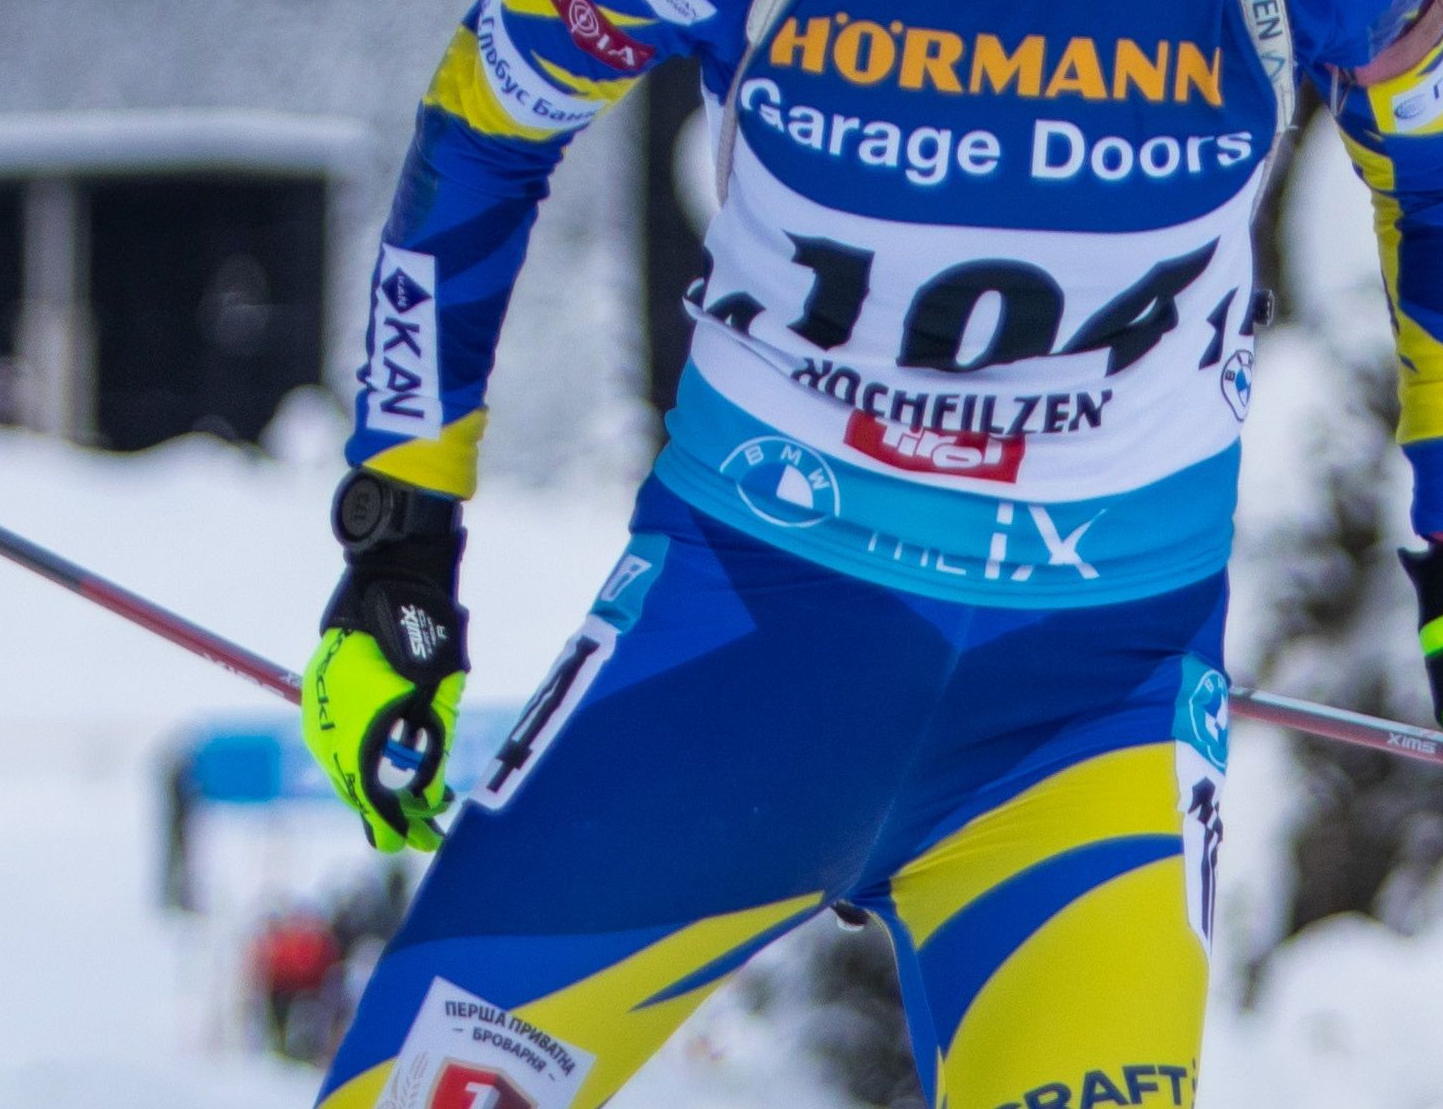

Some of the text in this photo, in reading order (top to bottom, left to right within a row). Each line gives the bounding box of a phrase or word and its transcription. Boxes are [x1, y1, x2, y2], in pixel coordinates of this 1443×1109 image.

[769, 10, 1225, 108] HÖRMANN
[740, 76, 1254, 186] Garage Doors
[781, 227, 1222, 377] 104
[379, 316, 426, 420] KAN
[744, 444, 831, 491] BMW
[444, 999, 577, 1078] ПЕРША ПРИВАТНА
[471, 1025, 548, 1074] БРОВАРНЯ
[992, 1063, 1188, 1109] RAFT
